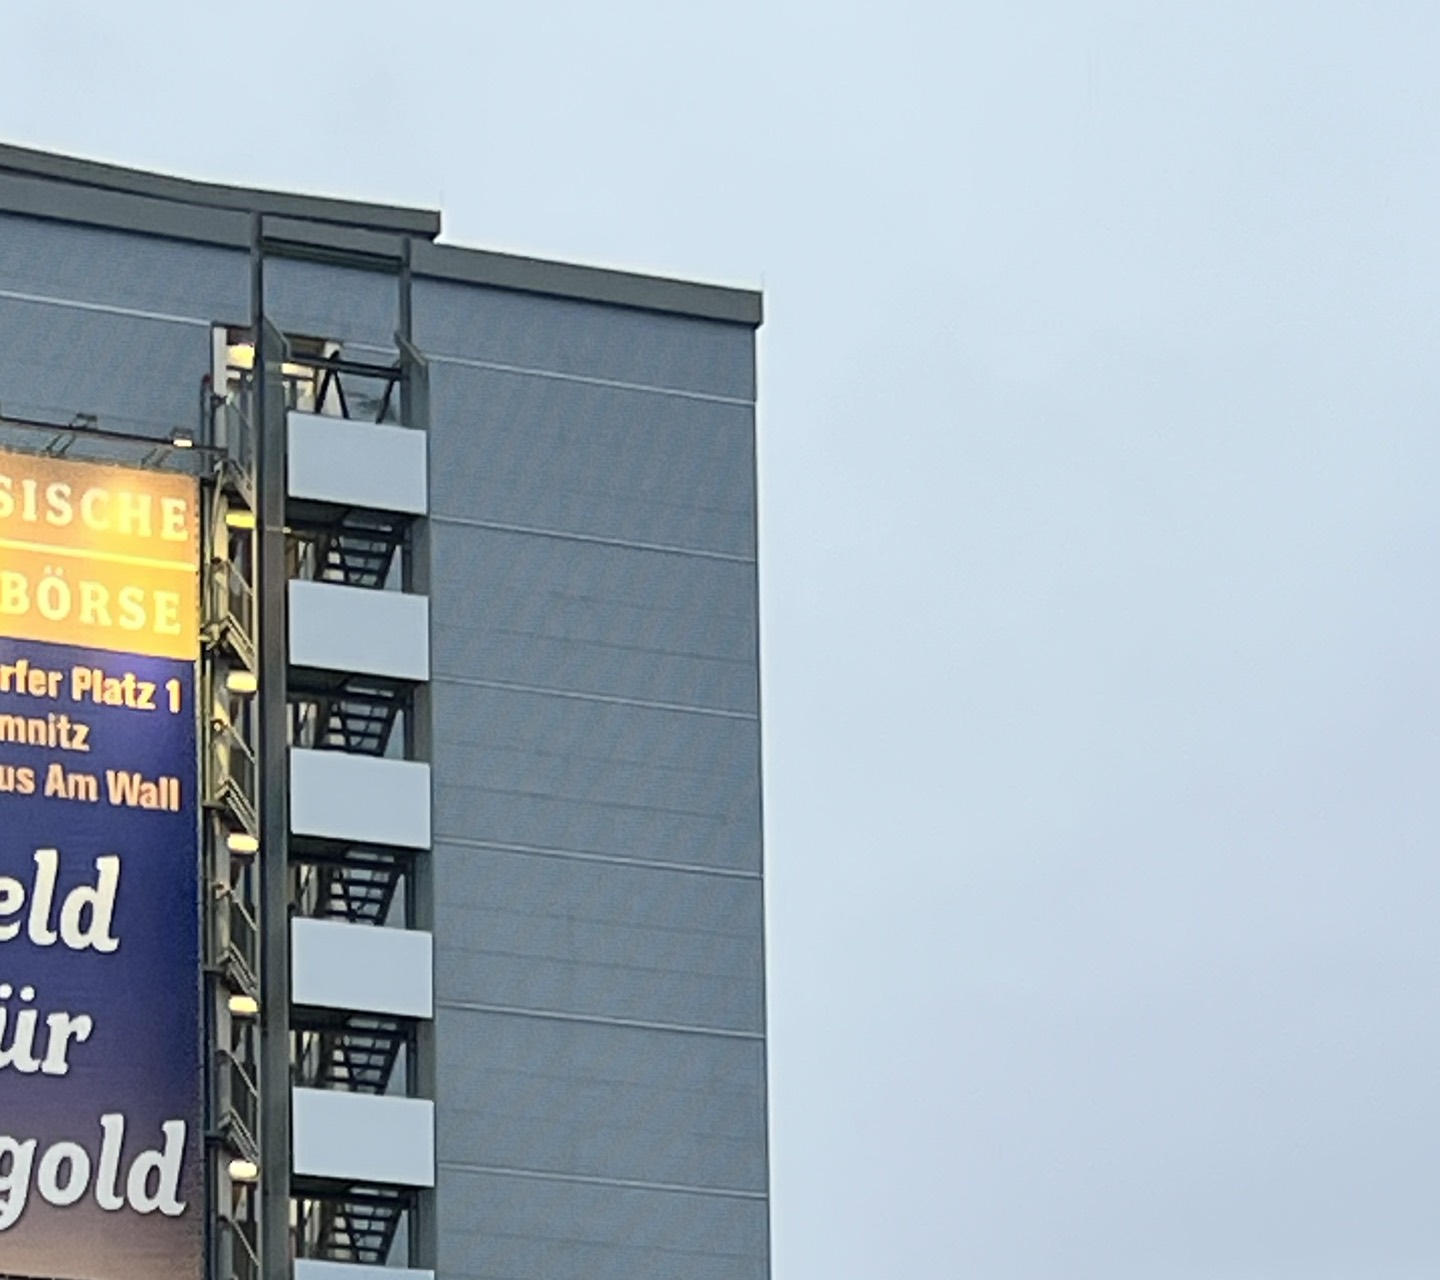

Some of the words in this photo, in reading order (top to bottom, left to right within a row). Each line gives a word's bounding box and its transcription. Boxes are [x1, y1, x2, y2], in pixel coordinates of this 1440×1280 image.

[72, 666, 155, 712] Platz
[166, 679, 181, 713] 1
[44, 763, 98, 801] Am
[106, 772, 180, 812] Wall
